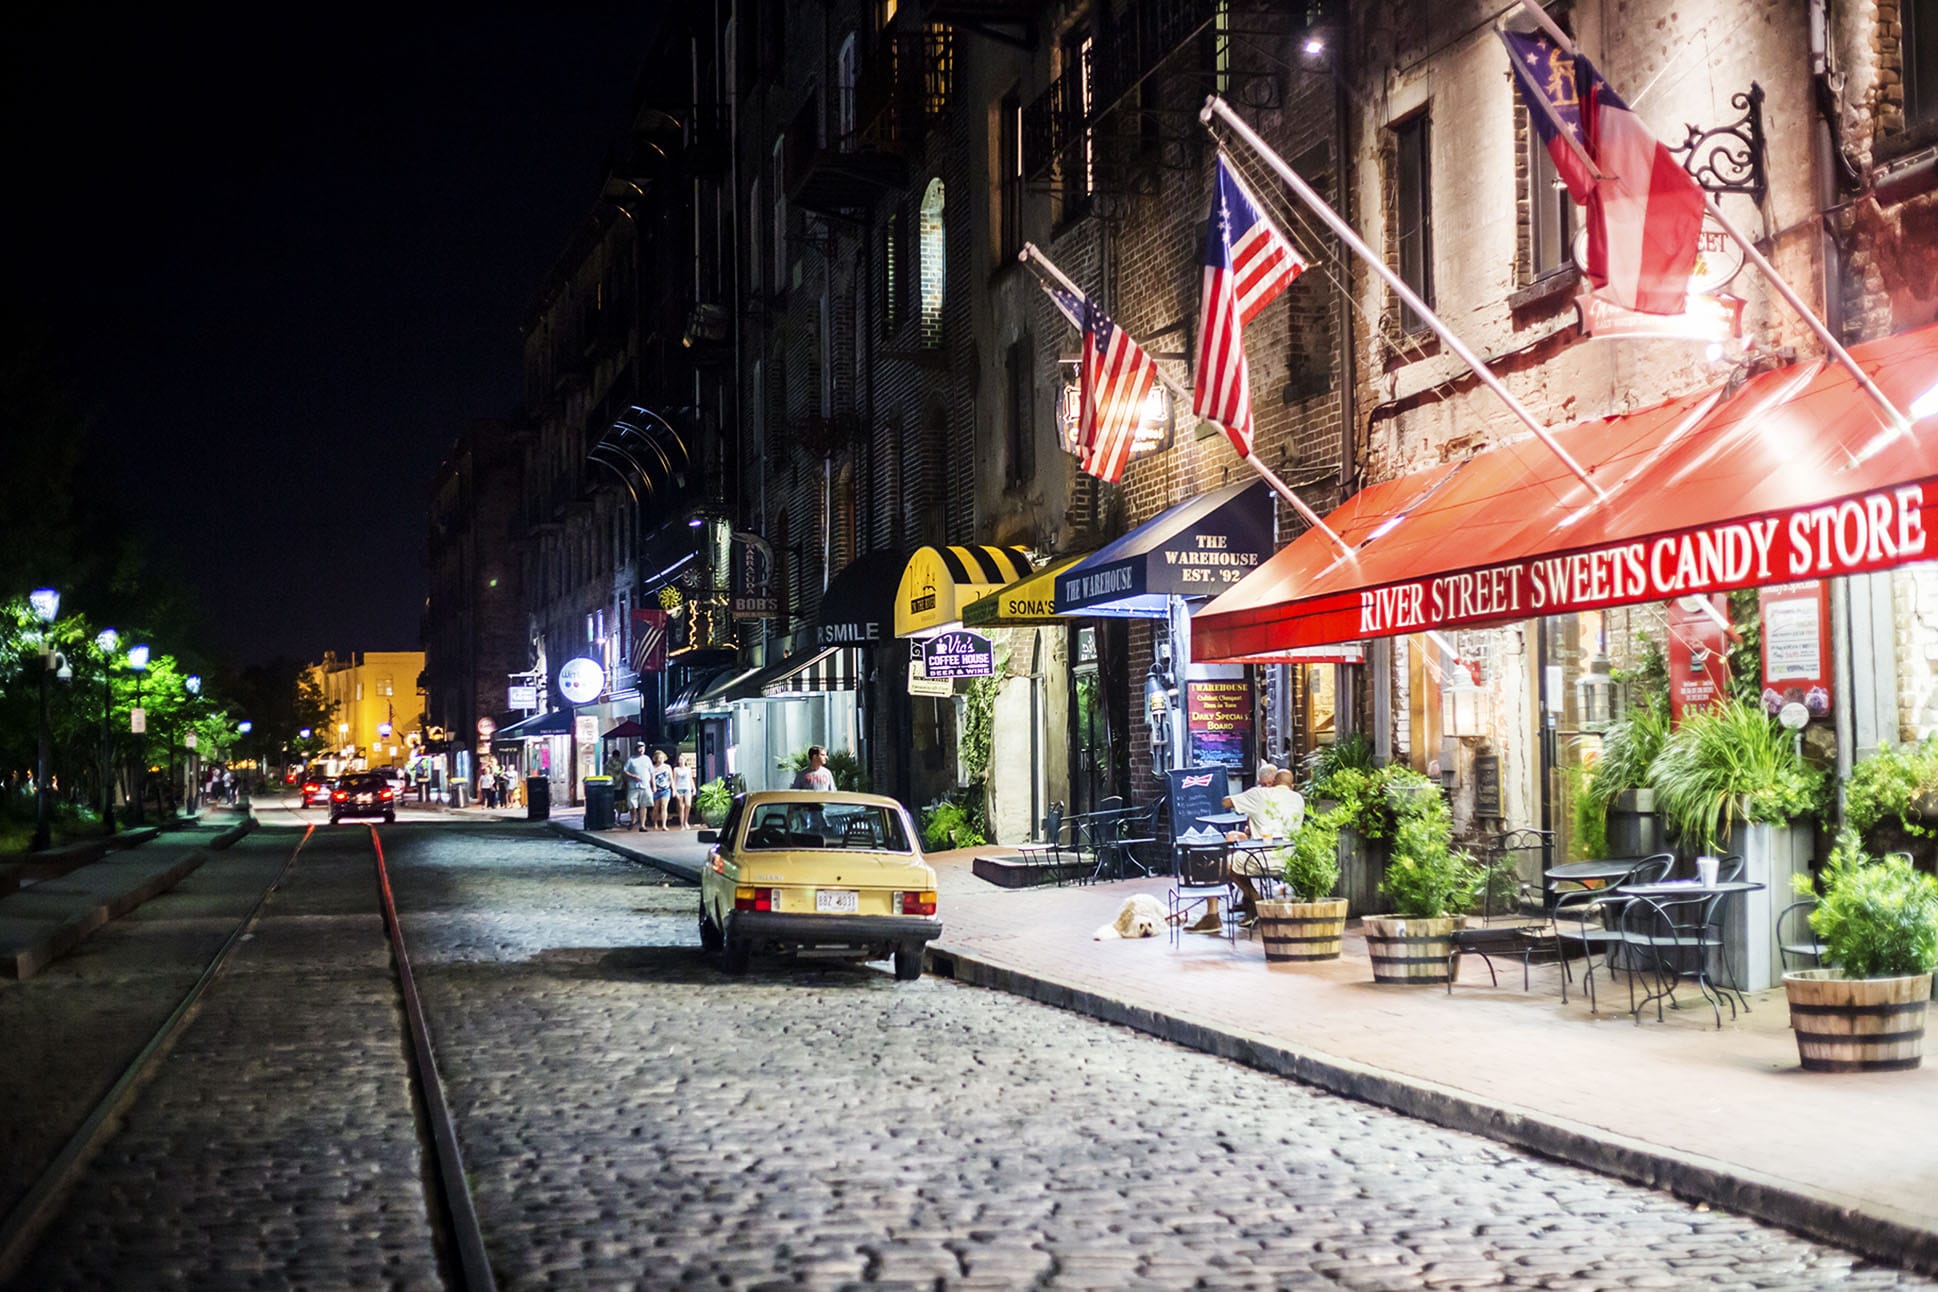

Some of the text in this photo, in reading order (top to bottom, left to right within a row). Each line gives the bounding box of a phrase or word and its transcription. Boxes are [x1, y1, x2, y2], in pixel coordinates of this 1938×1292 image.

[1196, 535, 1227, 548] THE
[1165, 551, 1258, 566] WAREHOUSE
[1359, 484, 1926, 634] RIVER STREET SWEETS CANDY STORE
[1182, 568, 1241, 583] EST. '92
[1066, 566, 1133, 602] THE WAREHOUSE
[736, 599, 778, 610] BOB'S
[1009, 600, 1055, 615] SONA'S
[825, 623, 880, 643] SMILE
[943, 634, 975, 654] Vic's
[928, 653, 990, 666] COFFEE HOUSE
[965, 667, 990, 675] WINE
